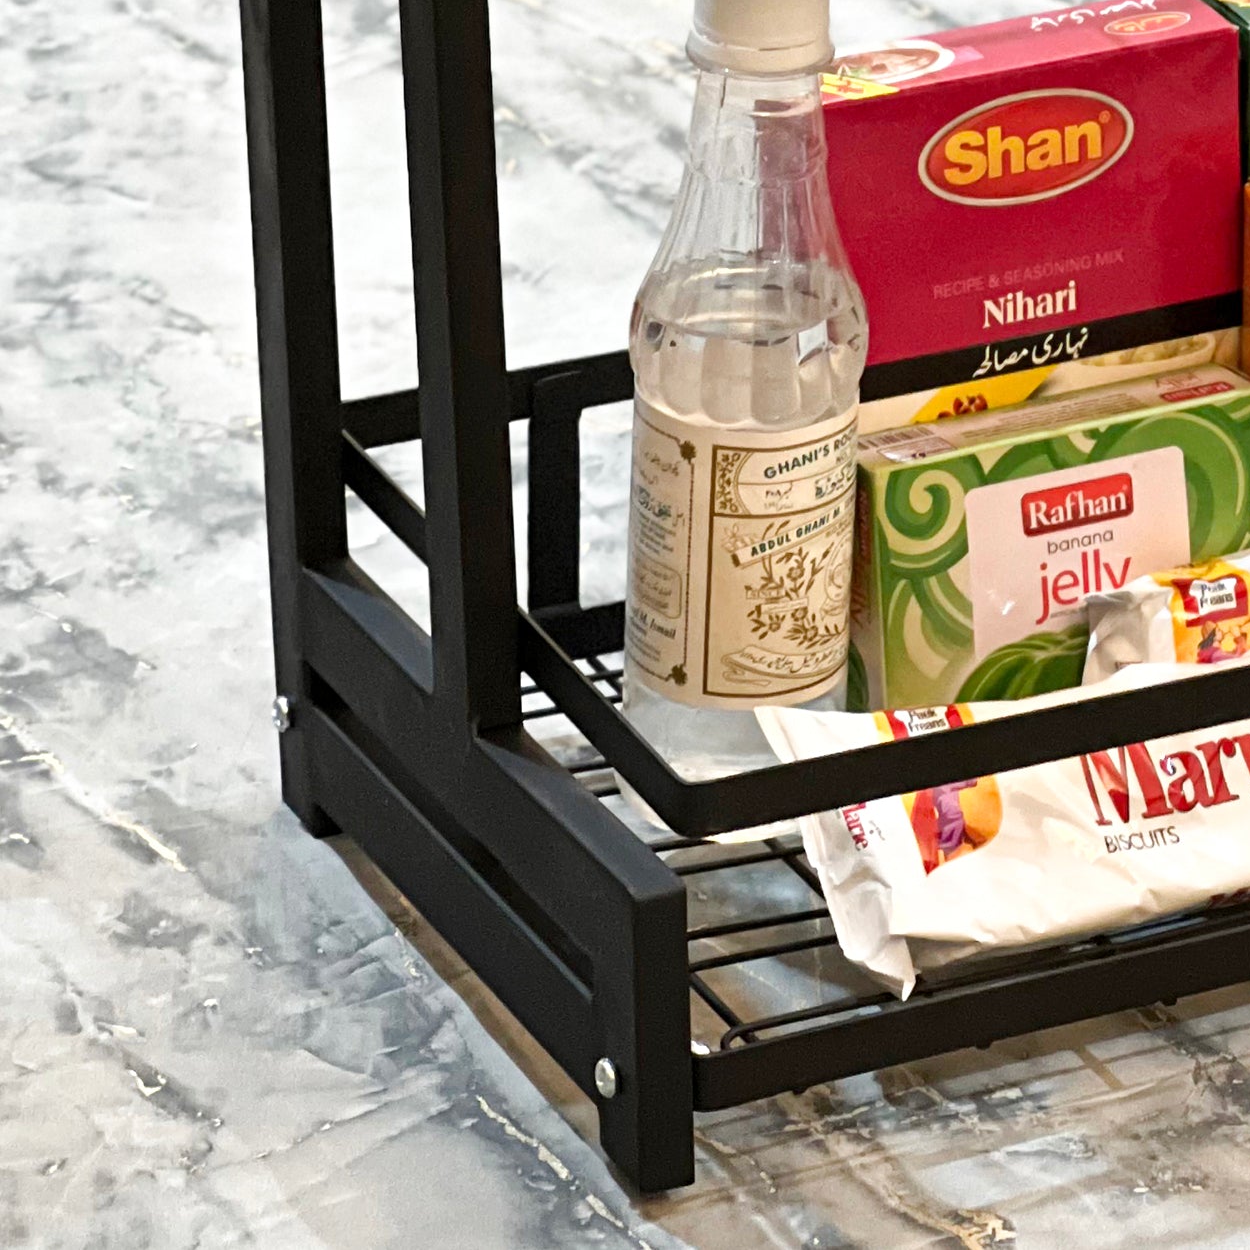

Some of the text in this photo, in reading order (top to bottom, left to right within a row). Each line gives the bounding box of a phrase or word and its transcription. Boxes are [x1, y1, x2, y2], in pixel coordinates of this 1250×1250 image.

[943, 118, 1103, 187] Shan
[933, 251, 1125, 300] RECIPE & SEASONING MIX
[982, 279, 1078, 330] Nihari
[763, 444, 830, 480] GHANI'S
[1027, 488, 1129, 532] Rafhan
[750, 530, 793, 558] ABDUL
[795, 514, 831, 540] GHANI
[1046, 528, 1114, 556] banana
[1103, 826, 1181, 855] BISCUITS
